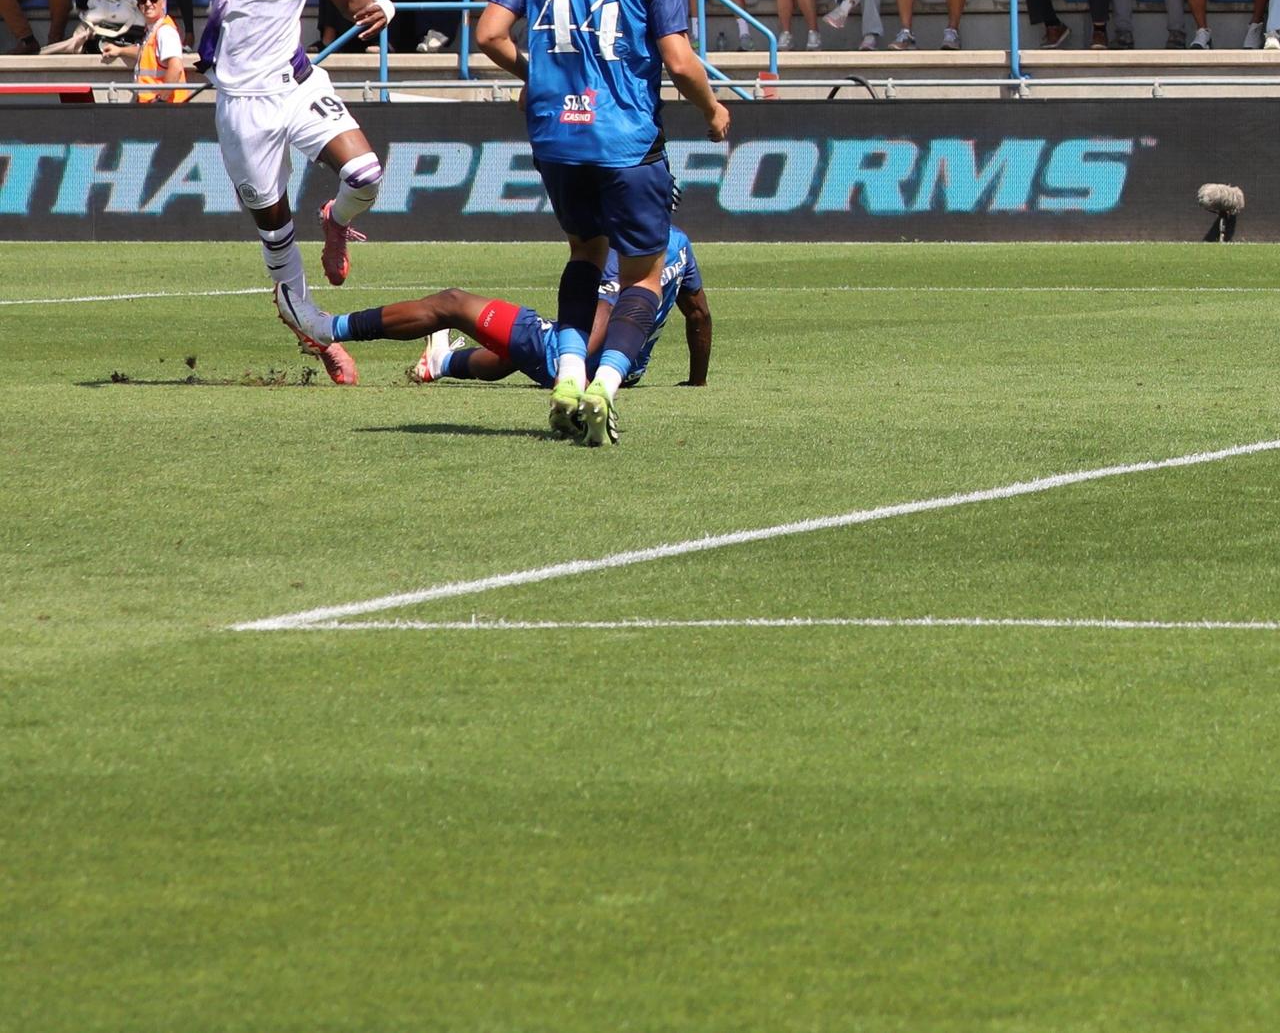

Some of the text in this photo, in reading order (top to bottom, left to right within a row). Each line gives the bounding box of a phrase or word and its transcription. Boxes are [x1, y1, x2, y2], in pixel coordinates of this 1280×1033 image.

[310, 96, 344, 119] 19
[563, 94, 592, 111] STAR
[563, 112, 591, 122] CASINO
[369, 139, 1133, 215] PEFORMS
